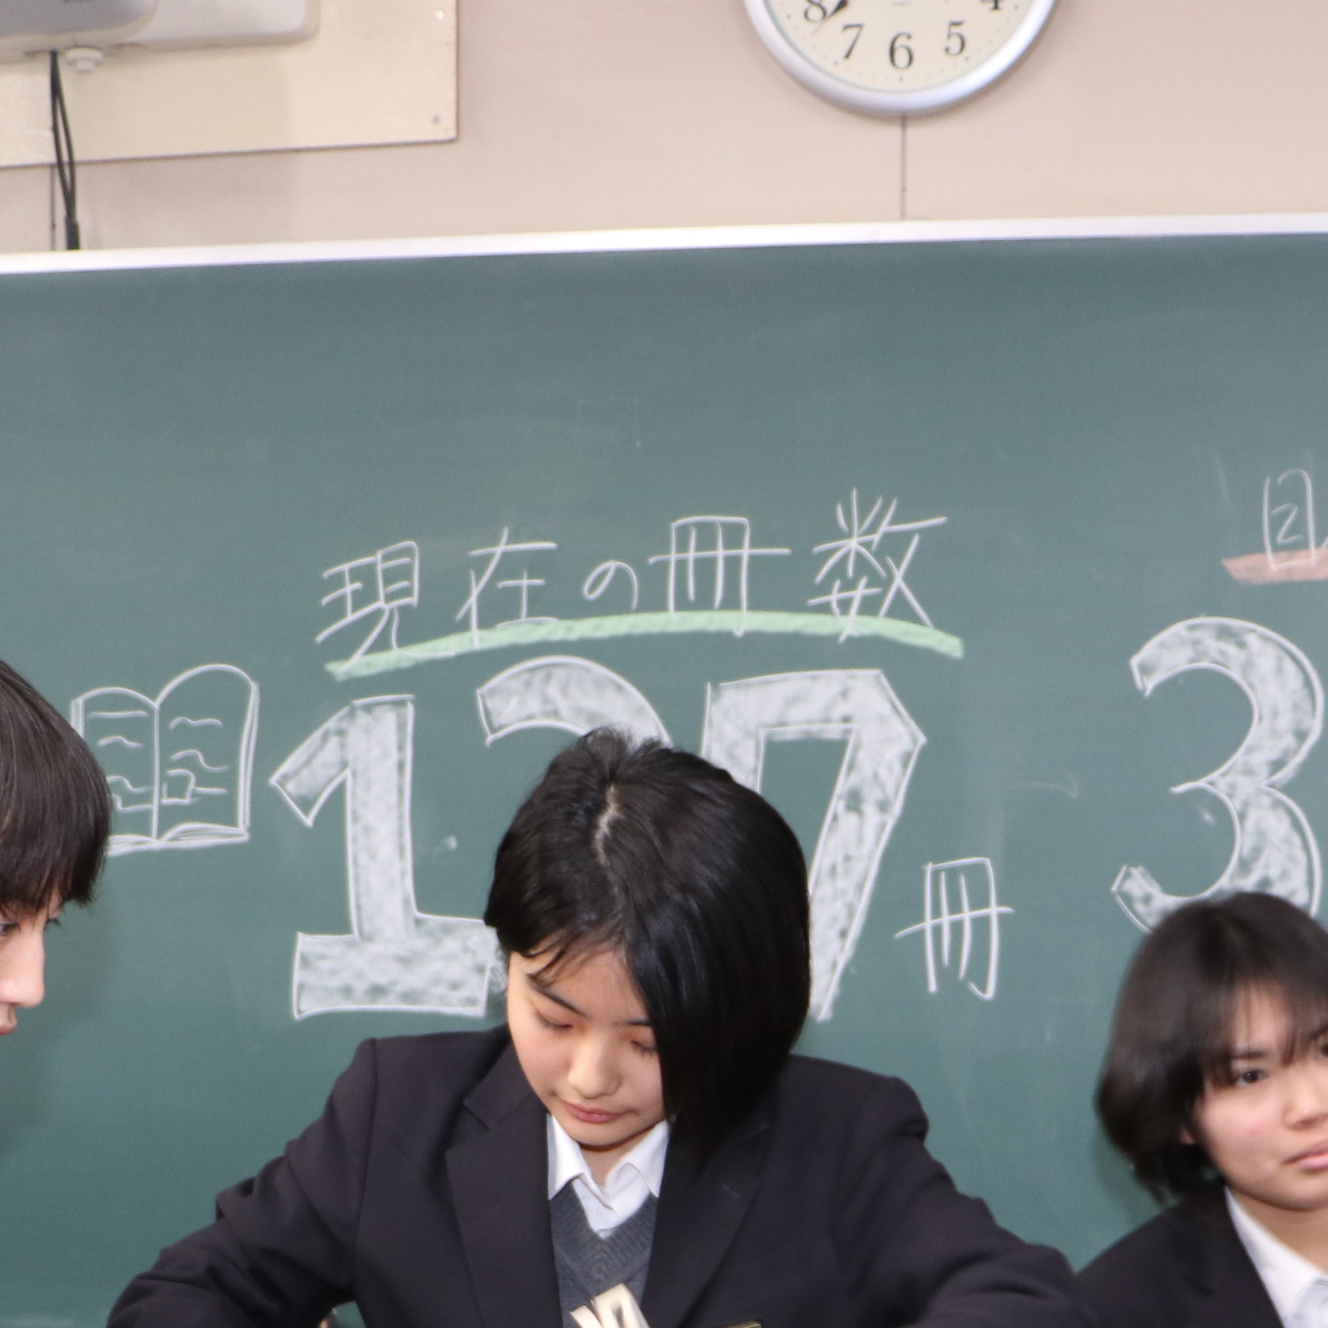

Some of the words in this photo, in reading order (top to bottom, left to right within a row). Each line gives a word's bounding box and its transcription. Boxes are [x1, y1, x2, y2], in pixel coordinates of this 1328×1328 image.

[841, 23, 865, 60] 7
[888, 33, 915, 70] 6
[944, 20, 966, 55] 5
[314, 488, 949, 673] 現在の冊数
[895, 855, 1015, 1000] 冊
